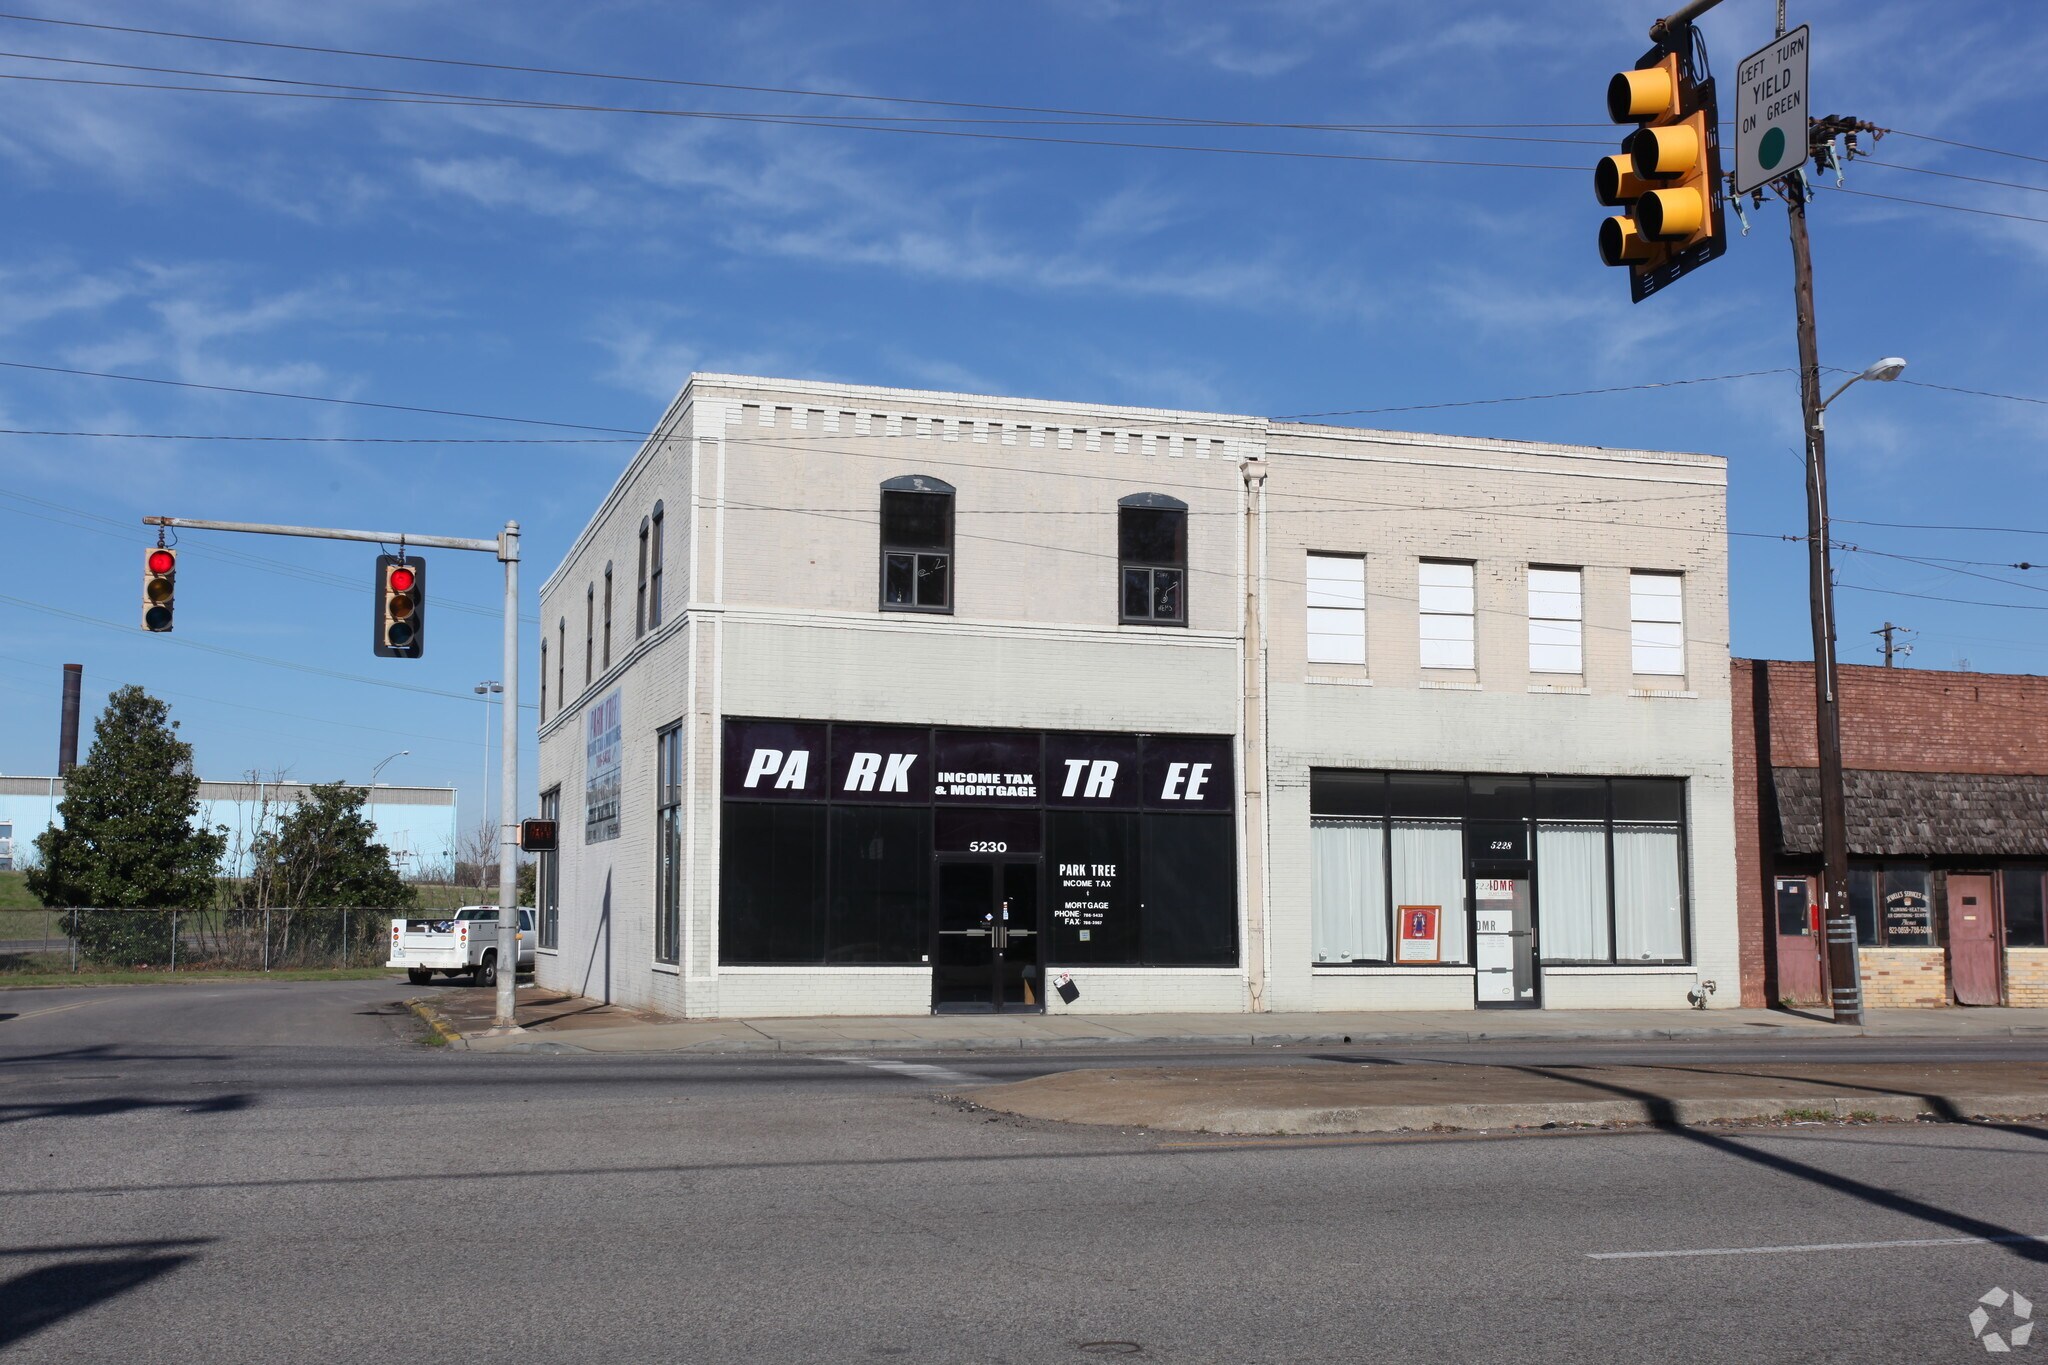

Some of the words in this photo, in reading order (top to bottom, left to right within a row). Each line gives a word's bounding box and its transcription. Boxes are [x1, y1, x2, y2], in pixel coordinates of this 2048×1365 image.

[1741, 59, 1765, 85] LEFT
[1777, 36, 1804, 64] TURN
[1753, 68, 1791, 105] YIELD
[1743, 114, 1756, 134] ON
[1767, 90, 1800, 121] GREEN
[938, 772, 1001, 785] INCOME
[1004, 773, 1034, 785] TAX
[935, 786, 947, 796] &
[951, 784, 1037, 798] MORTGAGE
[969, 841, 1008, 853] 5230
[1491, 841, 1512, 850] 5228
[1059, 864, 1086, 876] PARK
[1091, 865, 1116, 877] TREE
